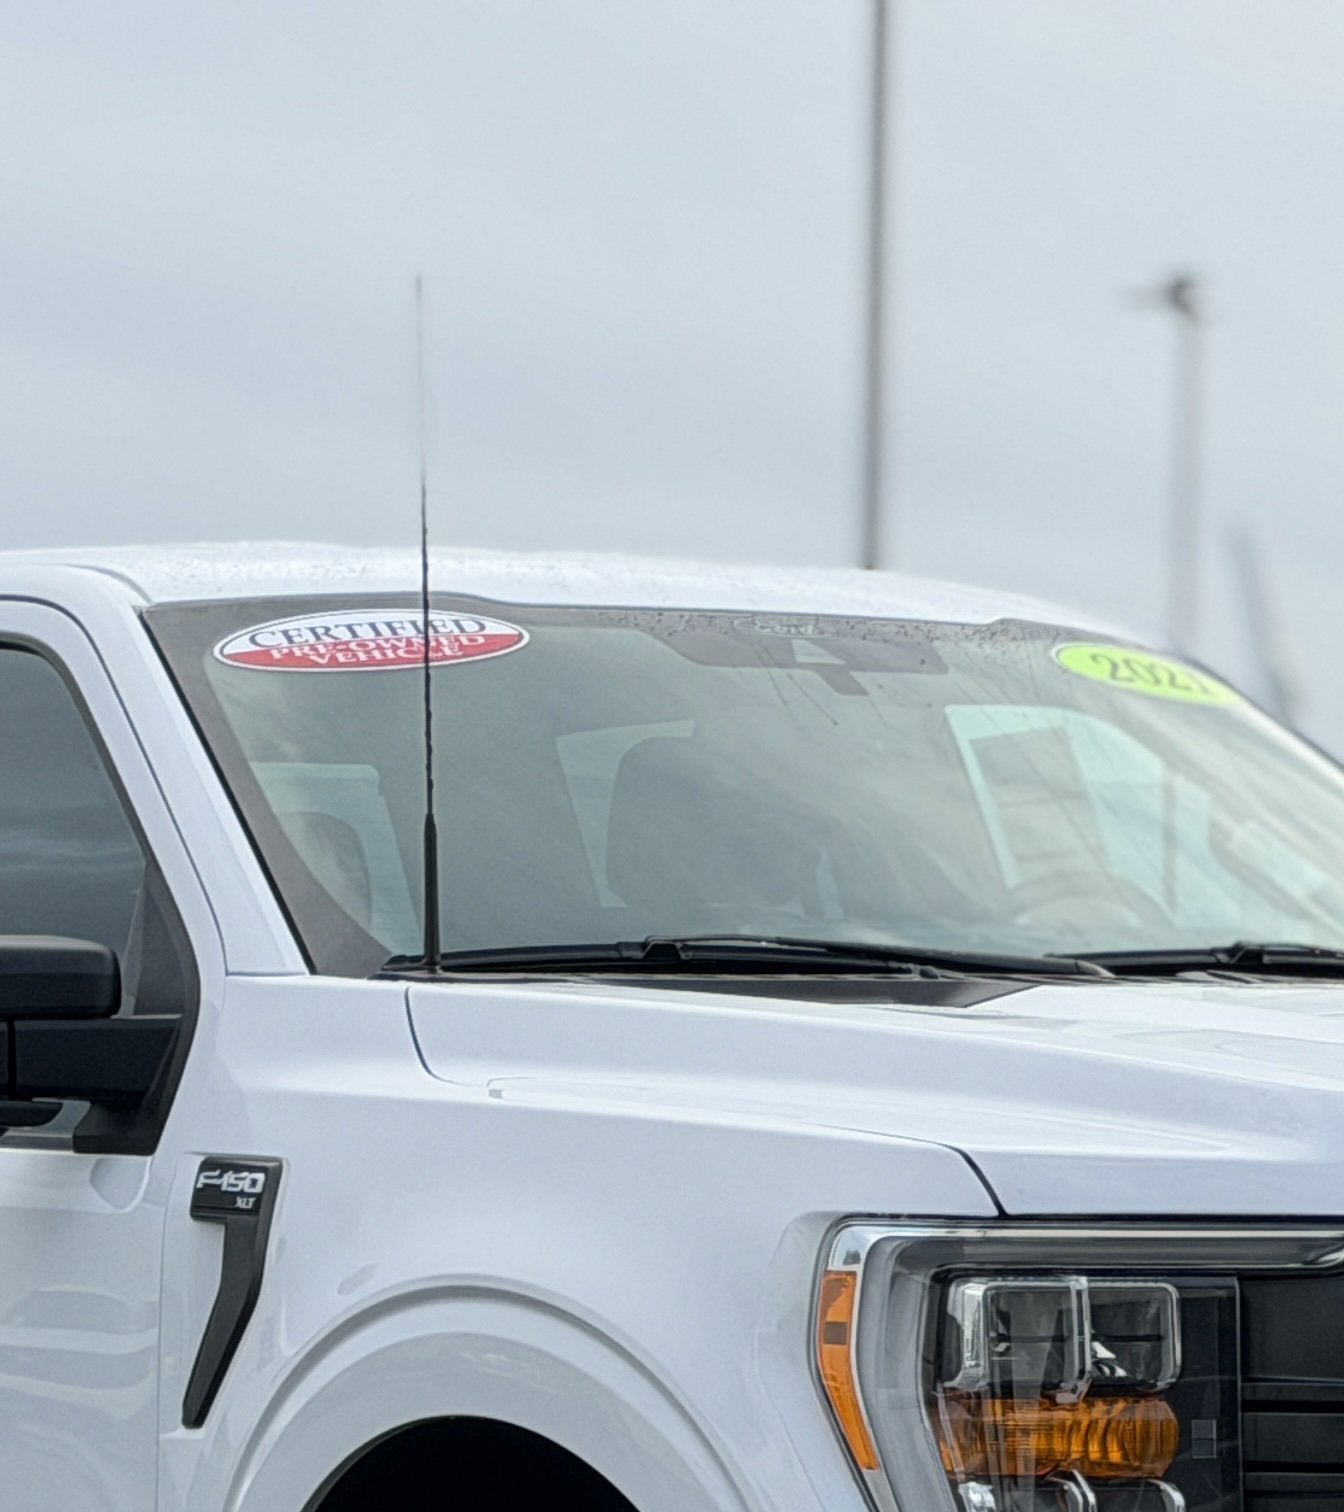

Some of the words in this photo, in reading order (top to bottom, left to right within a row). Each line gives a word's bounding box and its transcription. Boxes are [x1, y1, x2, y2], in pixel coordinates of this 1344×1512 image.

[248, 618, 487, 648] CERTIFIED
[270, 635, 486, 660] PRE-OWNED
[309, 646, 464, 665] VEHICLE
[1090, 653, 1212, 693] 2021
[197, 1169, 265, 1193] F-150
[235, 1197, 255, 1209] XLT
